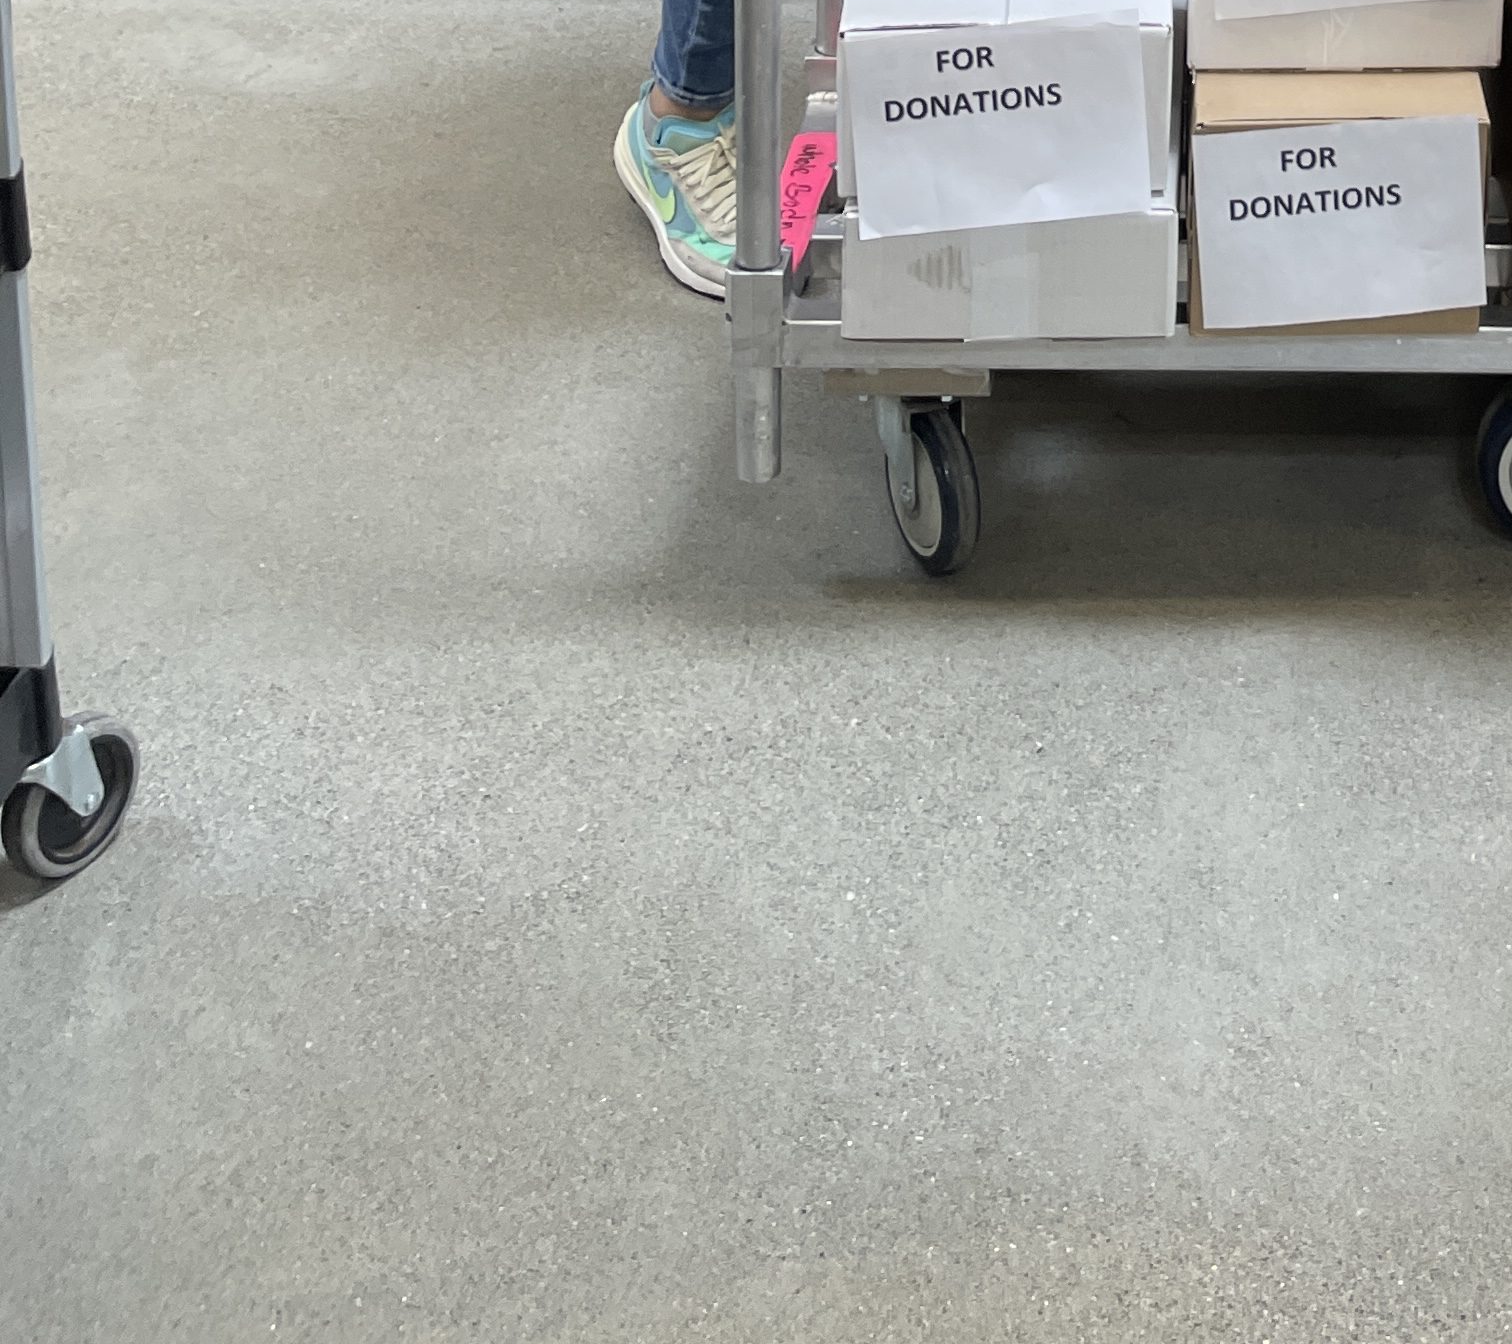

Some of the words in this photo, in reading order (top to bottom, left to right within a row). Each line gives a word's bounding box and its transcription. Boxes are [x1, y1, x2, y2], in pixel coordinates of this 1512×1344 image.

[935, 45, 995, 72] FOR
[884, 82, 1063, 123] DONATIONS
[1279, 146, 1337, 171] FOR
[1229, 183, 1402, 222] DONATIONS
